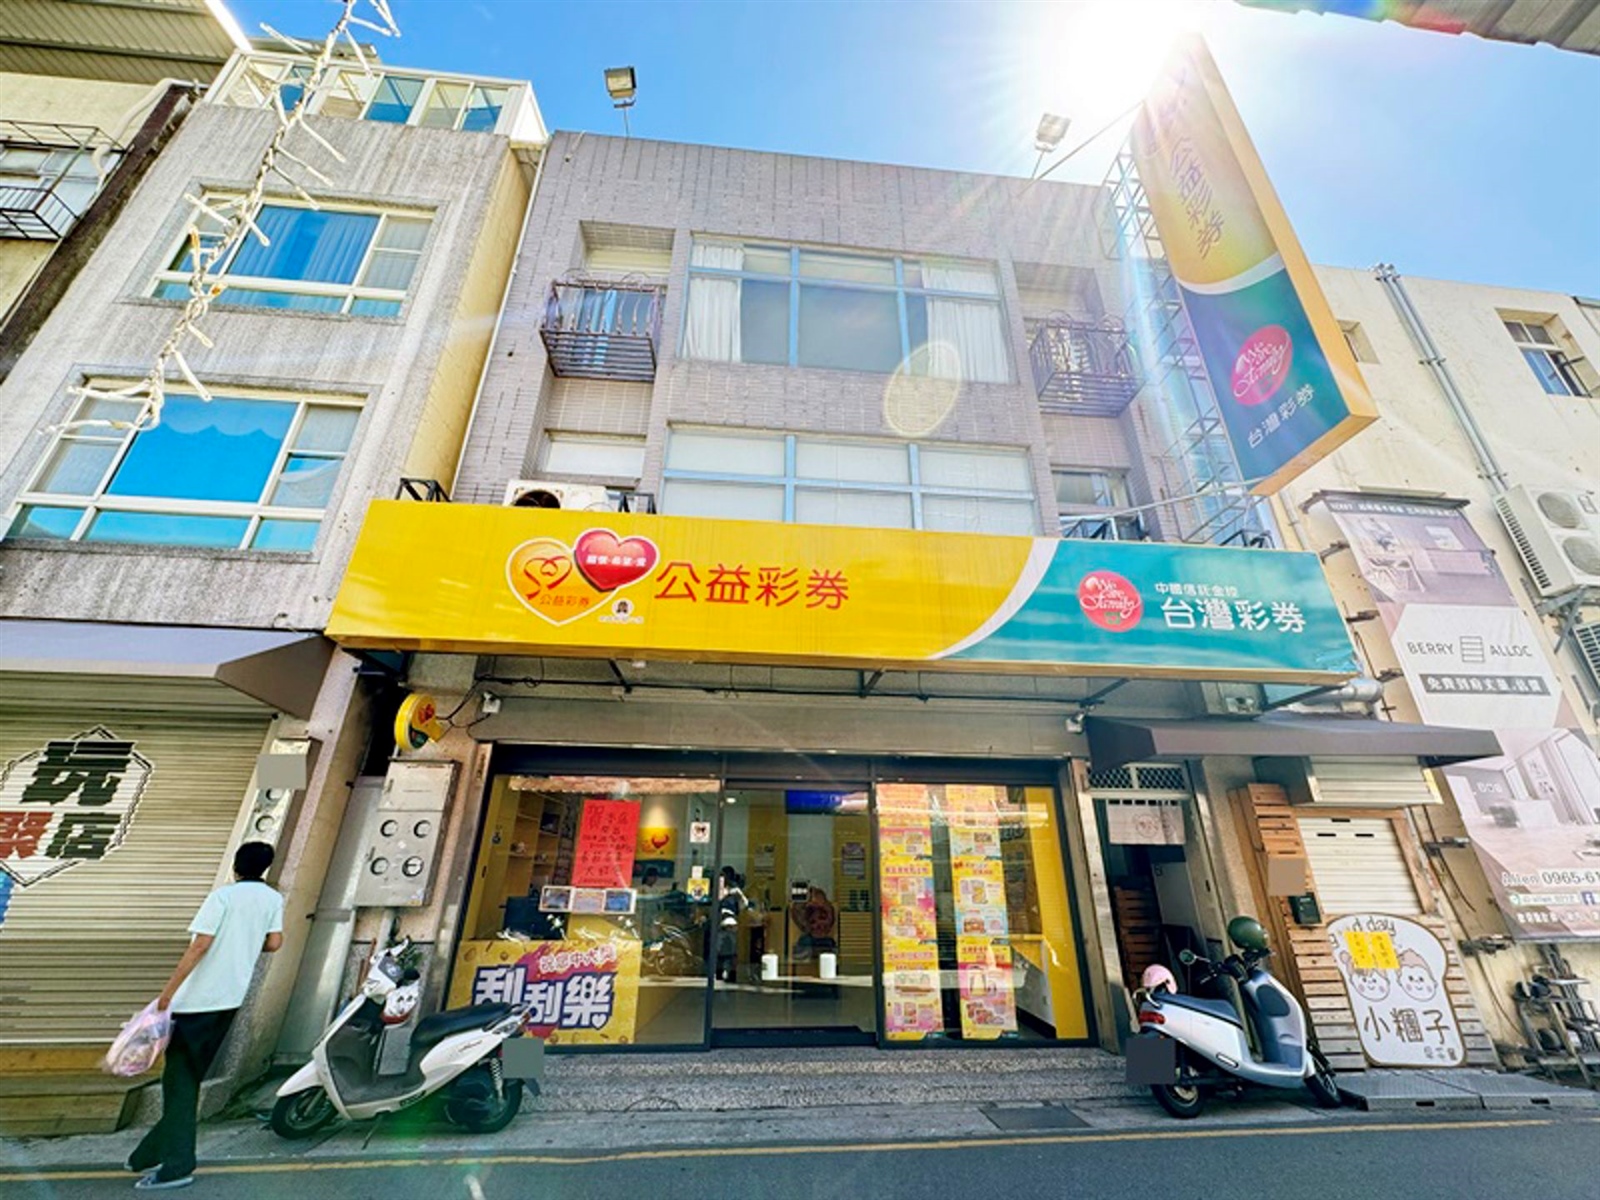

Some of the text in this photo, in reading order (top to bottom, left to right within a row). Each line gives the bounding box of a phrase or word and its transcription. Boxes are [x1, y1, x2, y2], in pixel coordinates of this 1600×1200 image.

[1248, 384, 1314, 449] 台灣彩券
[540, 594, 590, 608] 公益彩券
[653, 561, 850, 611] 公益彩券
[1160, 597, 1306, 633] 台灣彩券
[1407, 641, 1533, 657] BERRY ALLOC
[19, 741, 135, 807] 玩
[1502, 871, 1539, 886] Allen
[1366, 916, 1396, 937] day
[475, 967, 614, 1028] 刮刮樂
